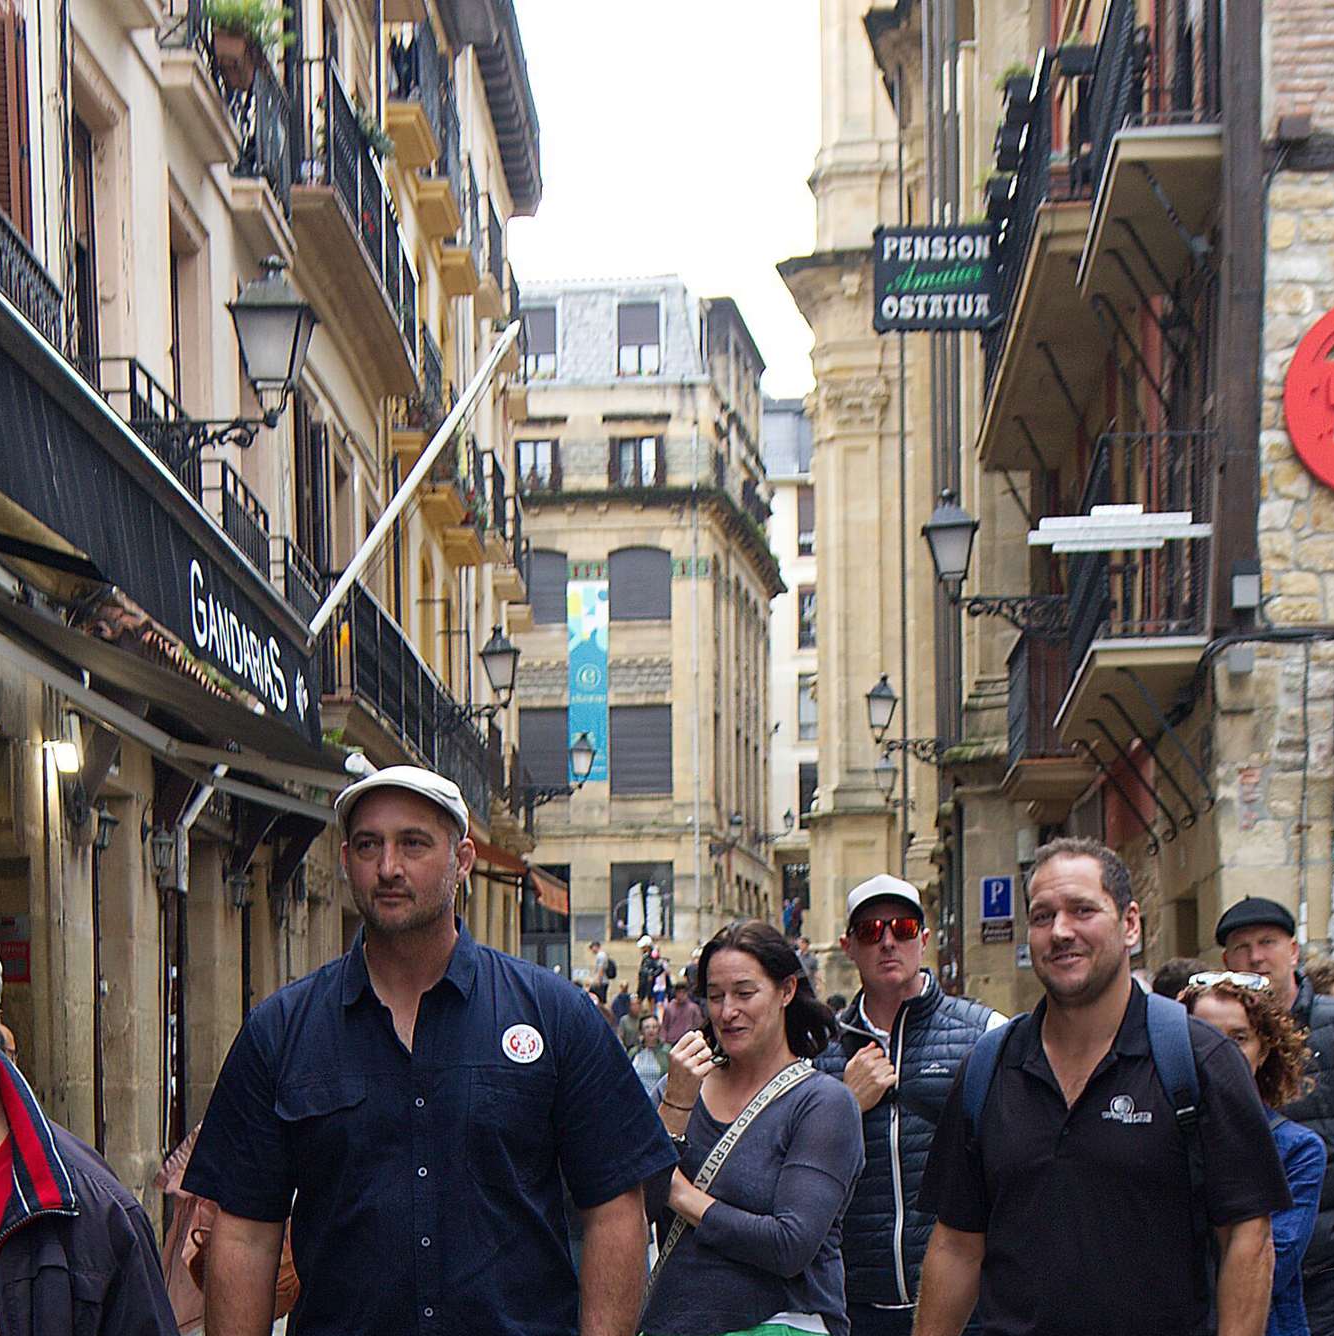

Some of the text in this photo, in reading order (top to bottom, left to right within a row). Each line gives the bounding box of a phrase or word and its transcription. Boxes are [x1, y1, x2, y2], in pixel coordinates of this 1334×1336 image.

[881, 293, 990, 319] OSTATUA
[190, 559, 288, 712] GANDARIAS
[991, 881, 1004, 904] P
[737, 1094, 769, 1128] SEED
[696, 1132, 738, 1190] HERITA
